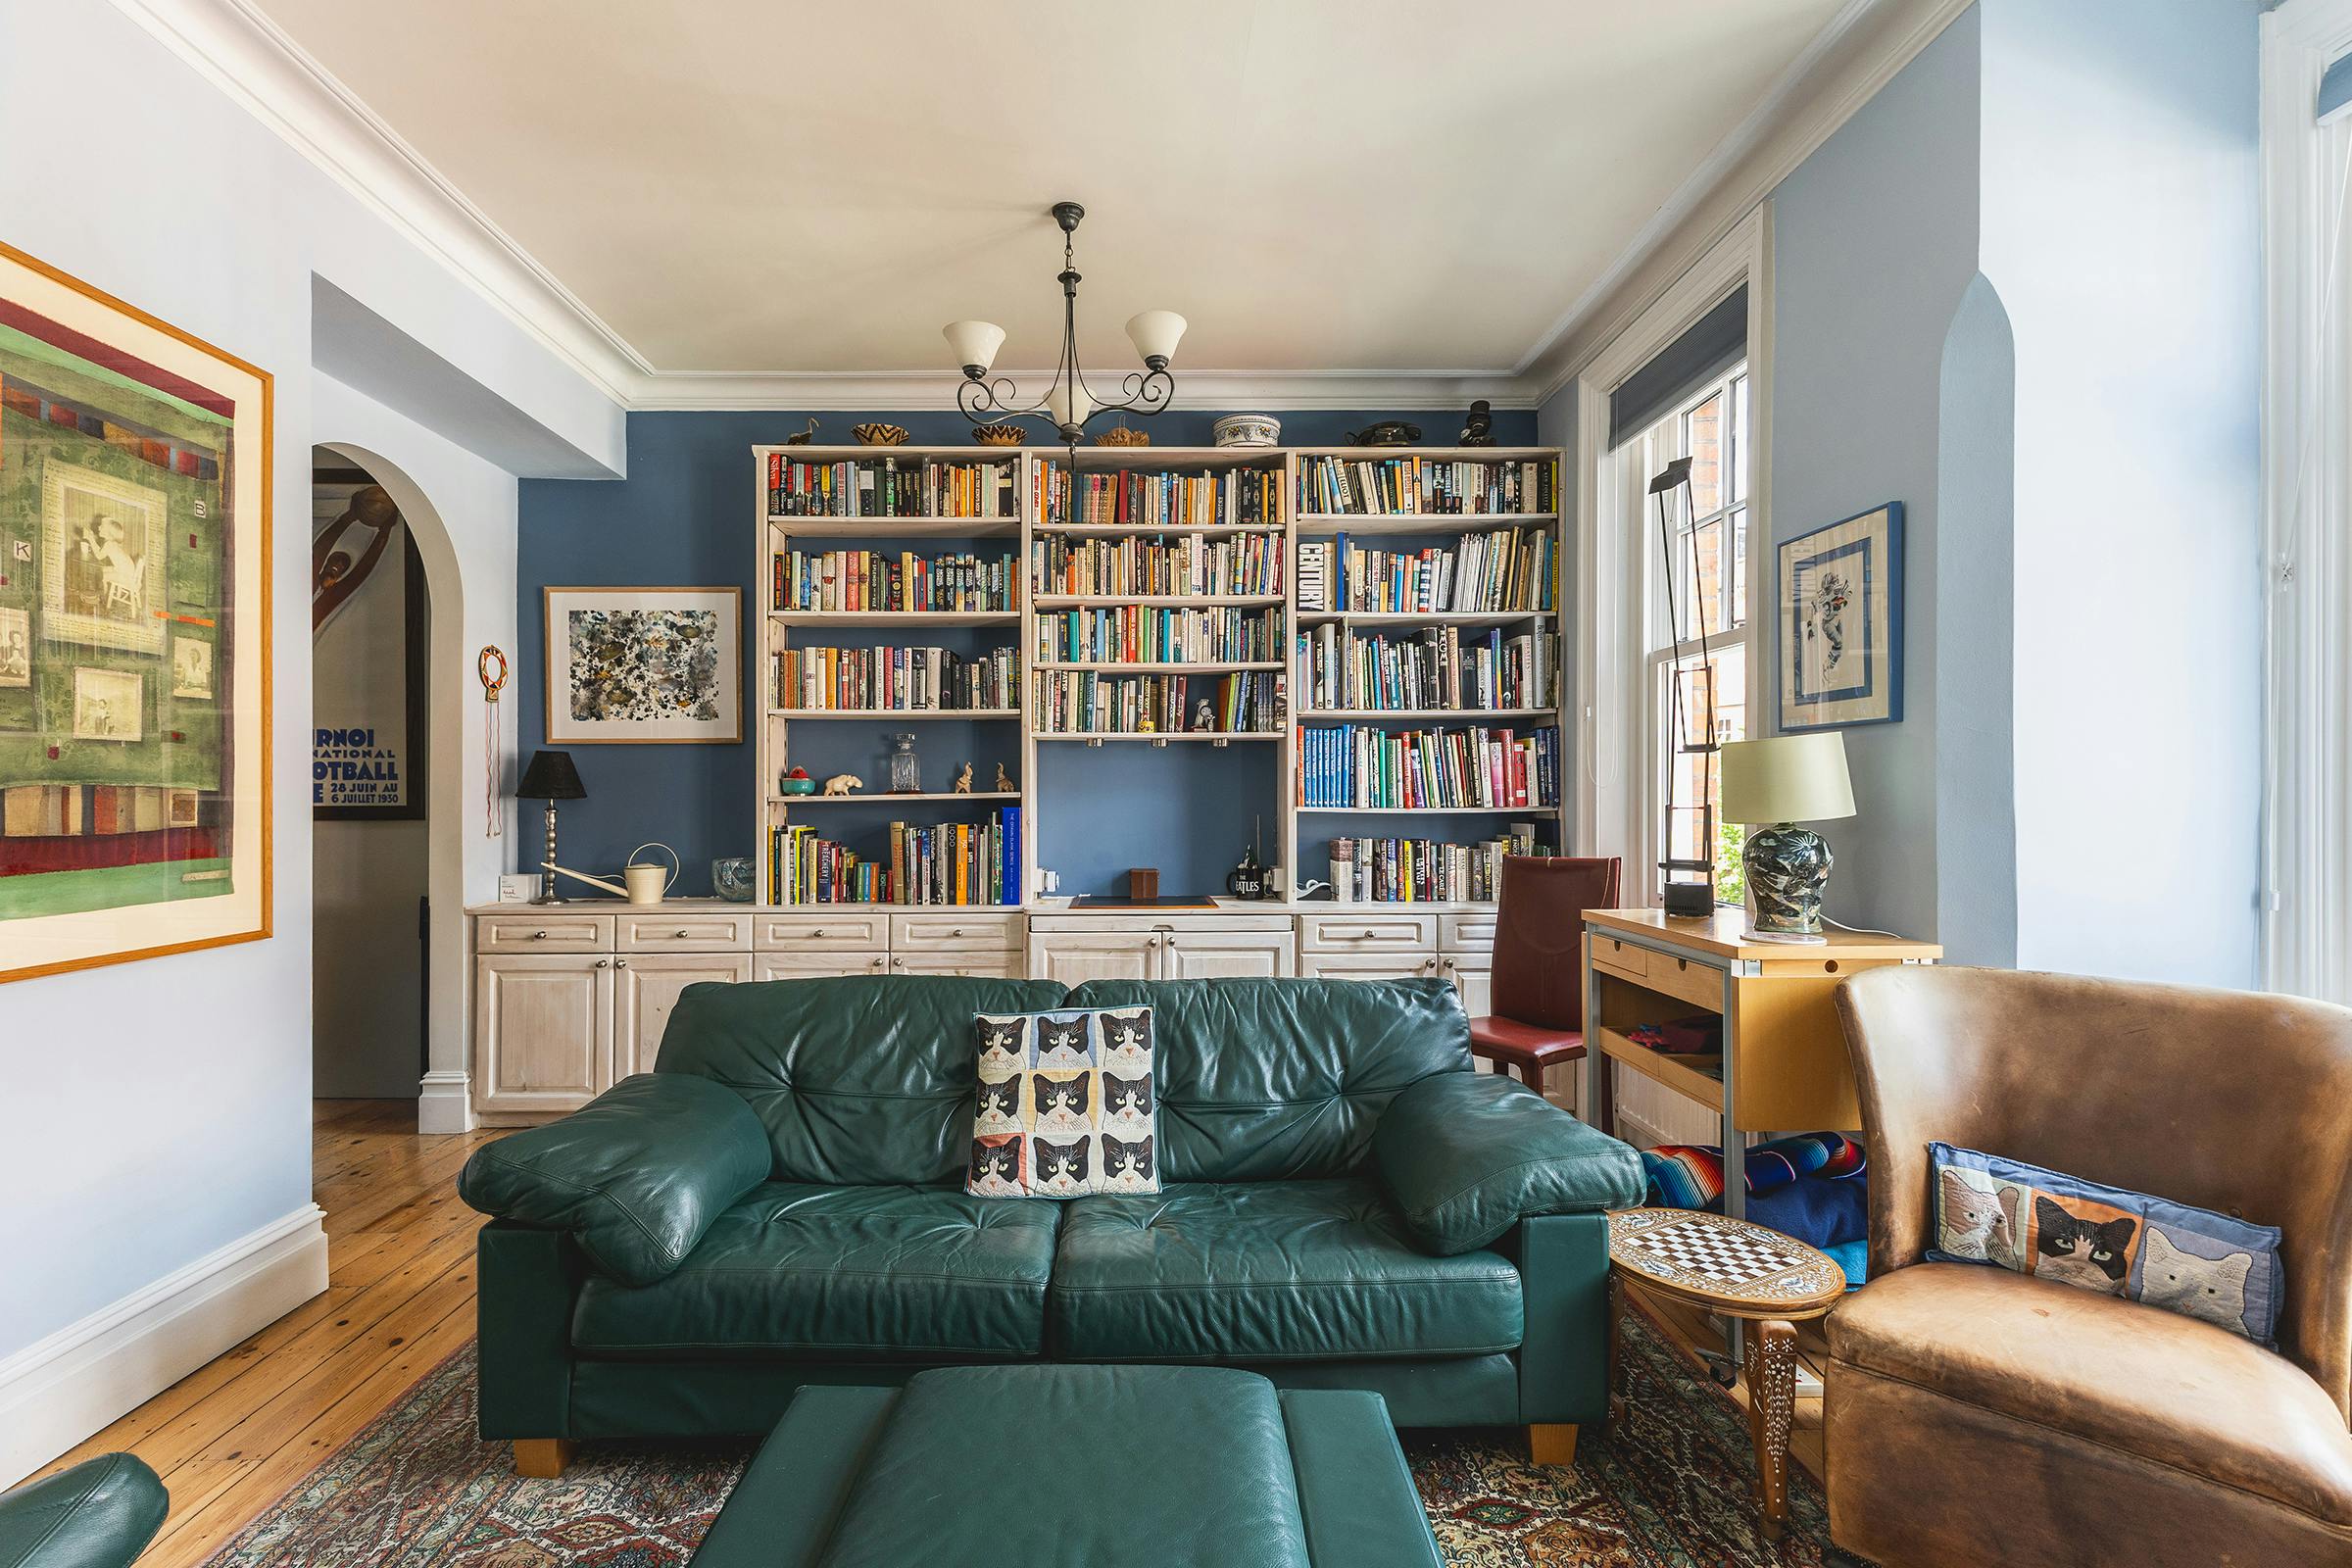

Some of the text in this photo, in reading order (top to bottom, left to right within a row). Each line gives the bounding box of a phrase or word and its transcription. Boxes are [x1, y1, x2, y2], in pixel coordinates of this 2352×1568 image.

[1339, 479, 1348, 499] ELIOT
[195, 503, 205, 516] B
[16, 543, 30, 559] K
[1298, 543, 1324, 611] CENTURY
[1477, 650, 1486, 687] Springsteen
[313, 728, 374, 747] RNOI
[330, 783, 398, 793] 28 JUIN AU
[331, 794, 339, 803] 6
[341, 794, 376, 803] JUILLET
[822, 844, 831, 877] TREACHERY
[1236, 881, 1259, 894] EATLES
